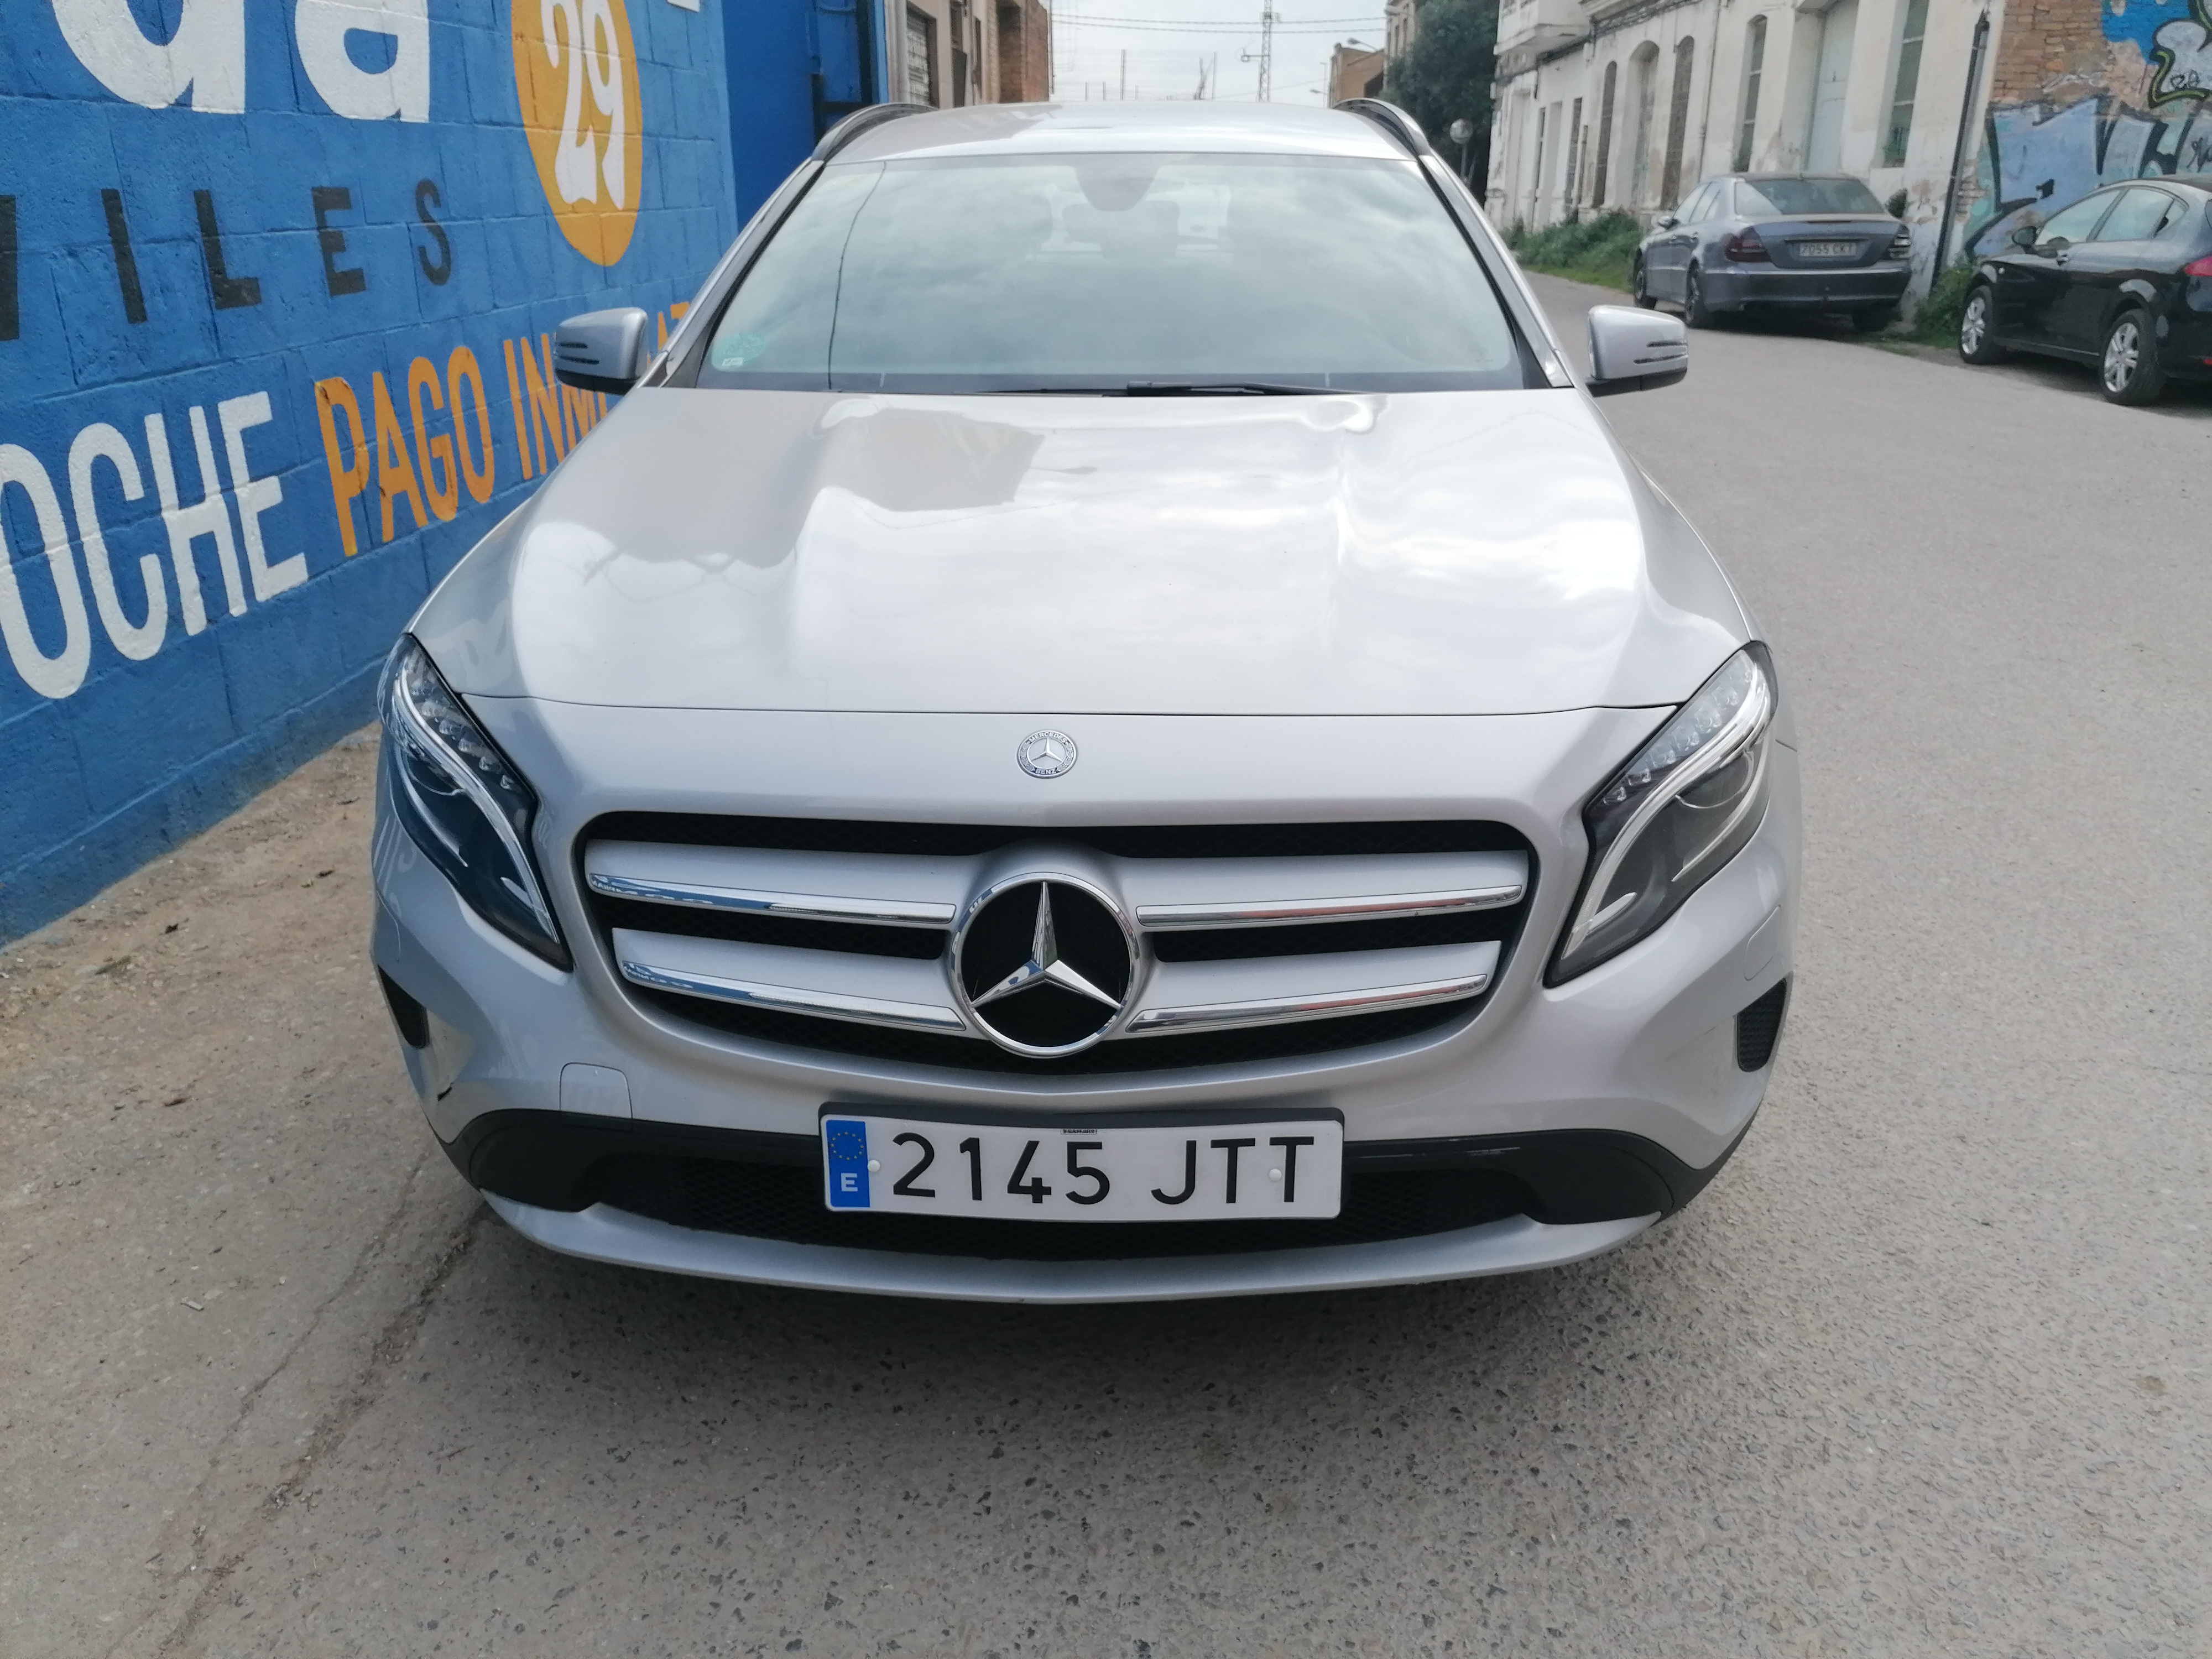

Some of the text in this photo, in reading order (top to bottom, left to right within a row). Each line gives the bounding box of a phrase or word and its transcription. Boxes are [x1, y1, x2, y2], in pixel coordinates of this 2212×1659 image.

[0, 390, 309, 699] OCHE
[314, 346, 495, 557] PAGO
[1028, 732, 1068, 743] MERCEDES
[841, 1172, 858, 1192] E
[891, 1132, 1315, 1206] 2145 JTT
